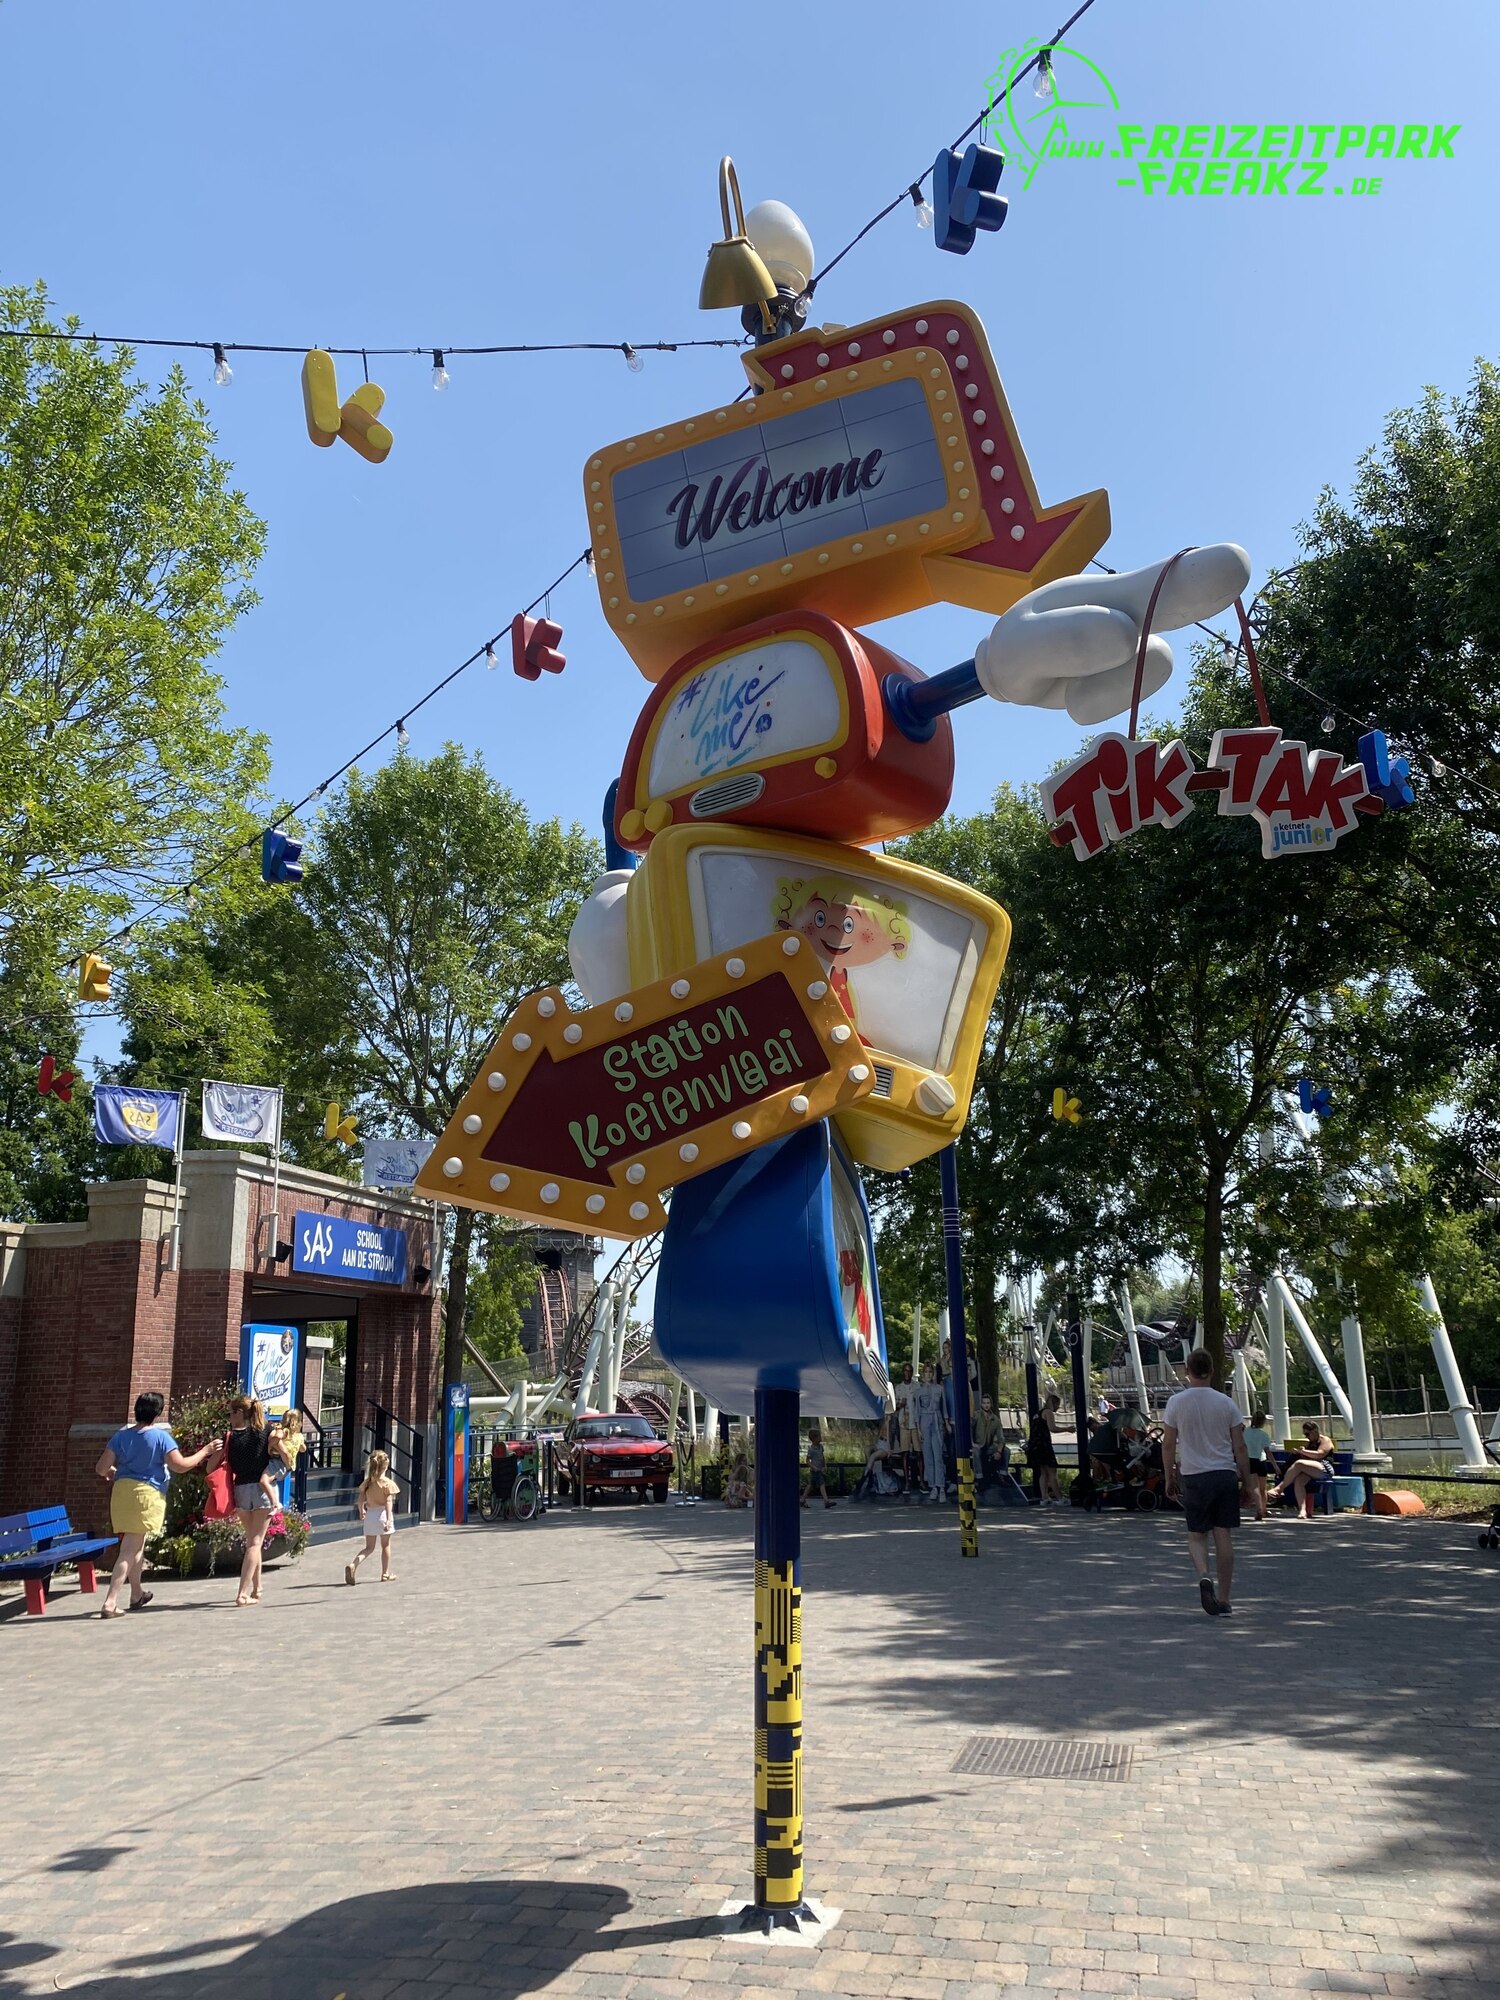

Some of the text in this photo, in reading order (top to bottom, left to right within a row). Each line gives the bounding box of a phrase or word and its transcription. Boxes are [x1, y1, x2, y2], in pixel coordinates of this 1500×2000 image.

[665, 449, 887, 549] Welcome
[1273, 824, 1333, 851] junior
[1279, 822, 1305, 831] ketnet
[603, 1005, 749, 1092] Station
[568, 1028, 803, 1169] Koeienvlaai
[303, 1221, 333, 1265] SAS
[356, 1229, 383, 1251] SCHOOL
[341, 1248, 395, 1273] AAN DE STROOM
[260, 1385, 284, 1399] COASTER
